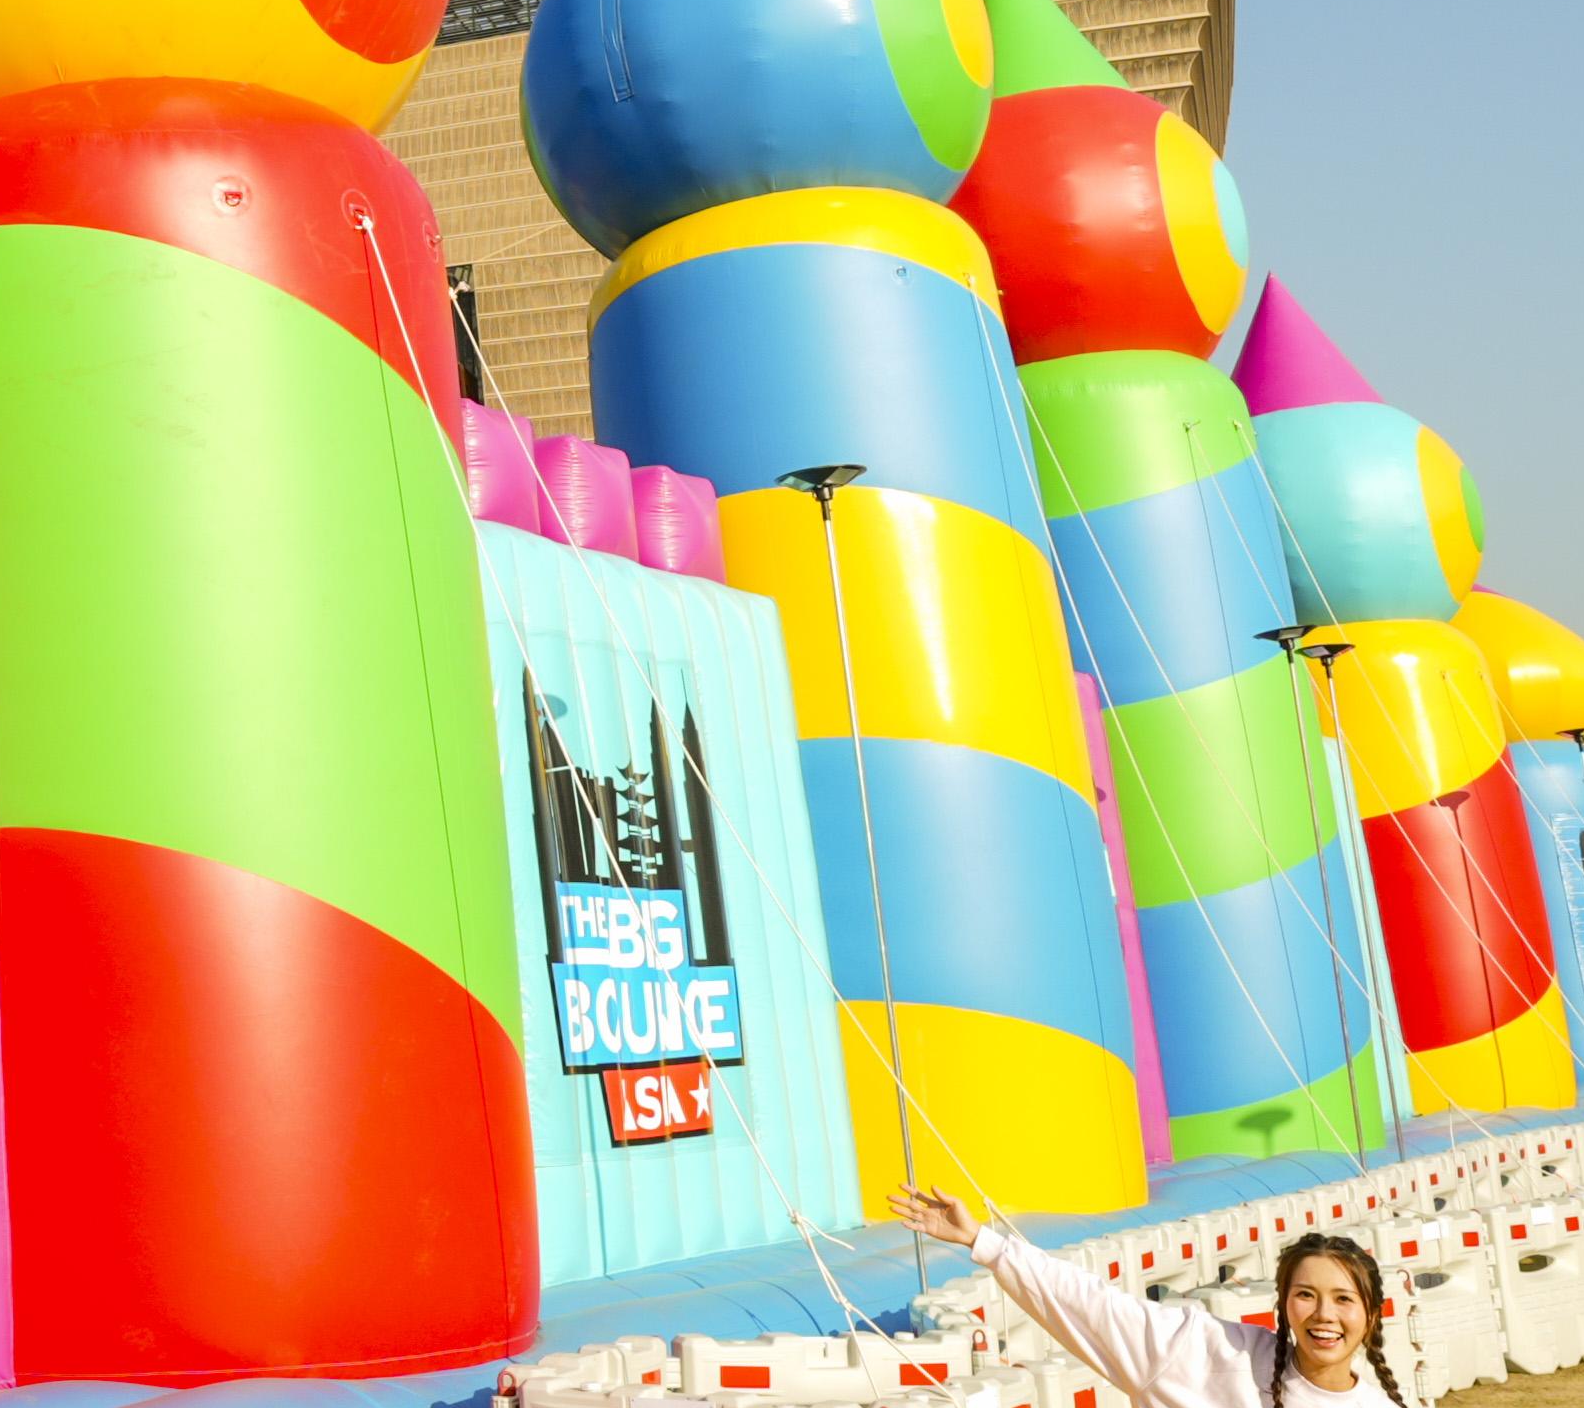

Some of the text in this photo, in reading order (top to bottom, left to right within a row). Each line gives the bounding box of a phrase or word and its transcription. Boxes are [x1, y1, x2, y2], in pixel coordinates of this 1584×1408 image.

[560, 896, 684, 970] THE BIG
[564, 977, 736, 1055] BOUNCE
